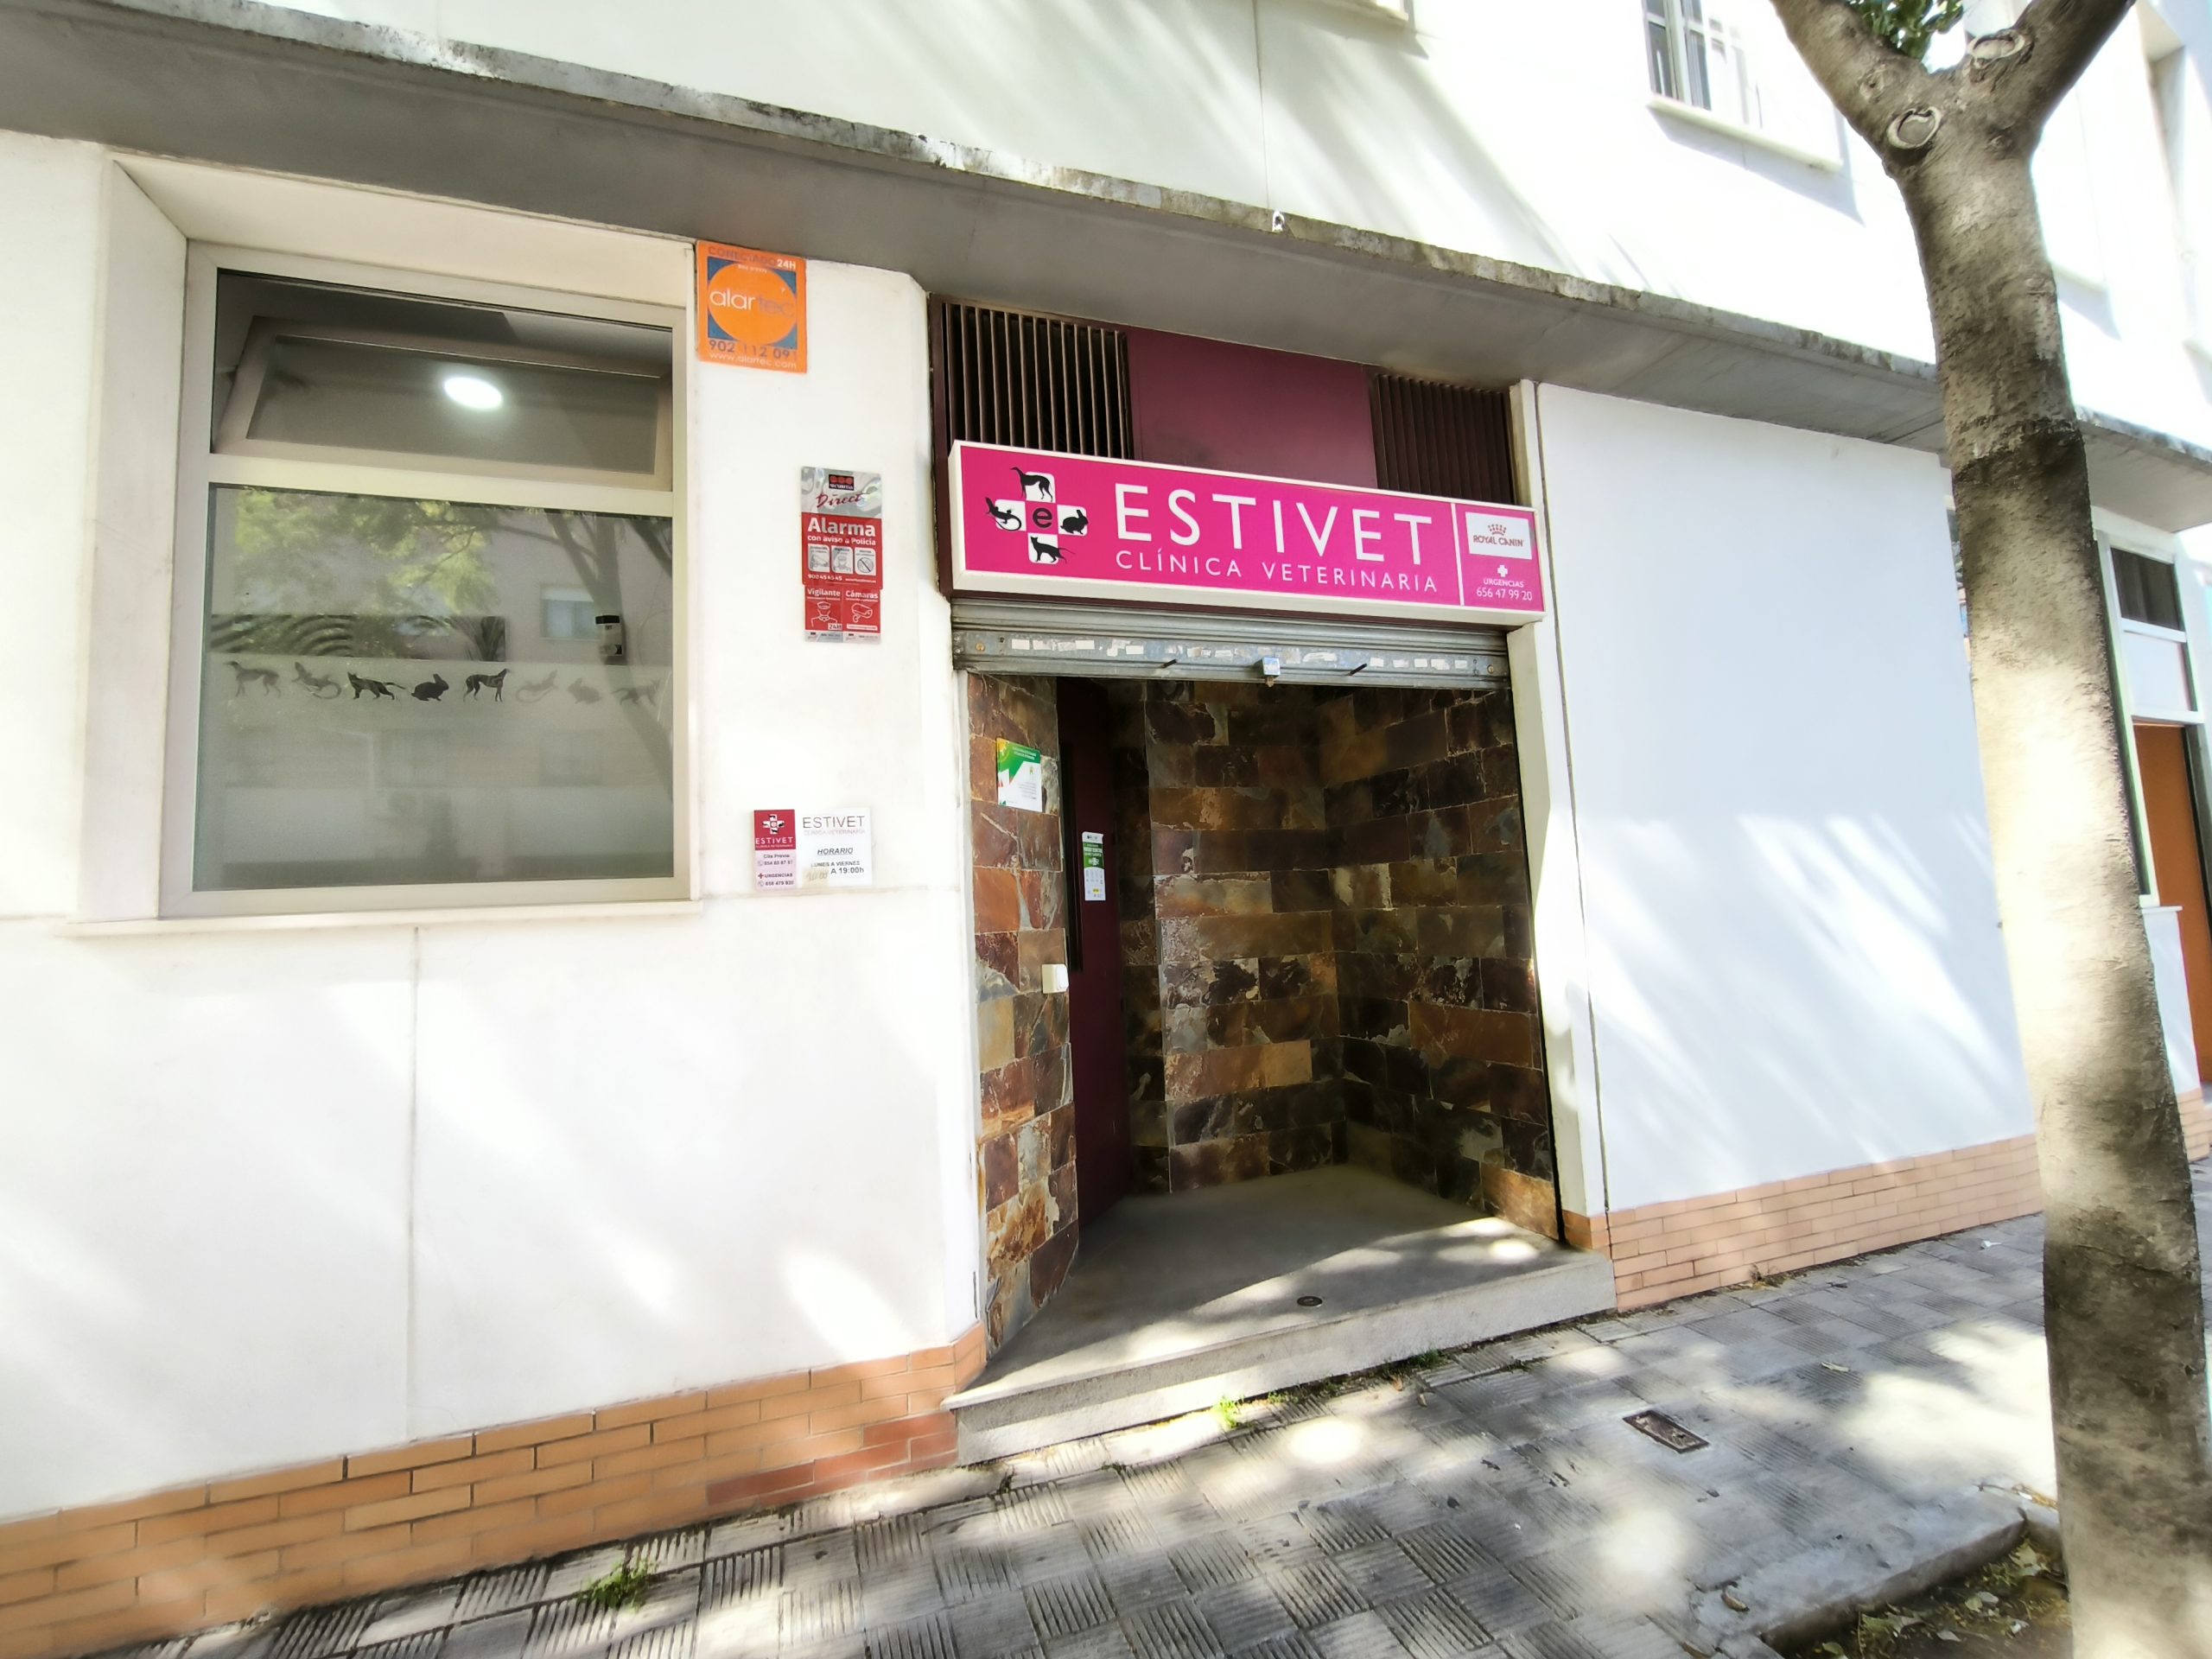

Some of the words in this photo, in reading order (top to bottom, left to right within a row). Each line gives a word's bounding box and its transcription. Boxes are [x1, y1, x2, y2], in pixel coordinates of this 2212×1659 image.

[777, 259, 796, 270] 24H
[709, 340, 734, 353] 902
[744, 344, 767, 357] 112
[816, 493, 862, 508] Direct
[807, 518, 876, 537] Alarma
[1115, 483, 1432, 565] ESTIVET
[1473, 535, 1497, 544] ROYAL
[1498, 537, 1523, 546] CANIN
[1116, 548, 1242, 577] CLÍNICA
[1262, 562, 1437, 593] VETERINARIA
[1483, 578, 1524, 588] URGENCIAS
[807, 588, 841, 597] Vigilante
[846, 589, 879, 599] Cámaras
[1477, 587, 1493, 598] 656
[1495, 588, 1506, 599] 47
[1509, 589, 1519, 600] 99
[1521, 591, 1533, 601] 20
[803, 816, 865, 828] ESTIVET
[817, 847, 854, 855] HORARIO
